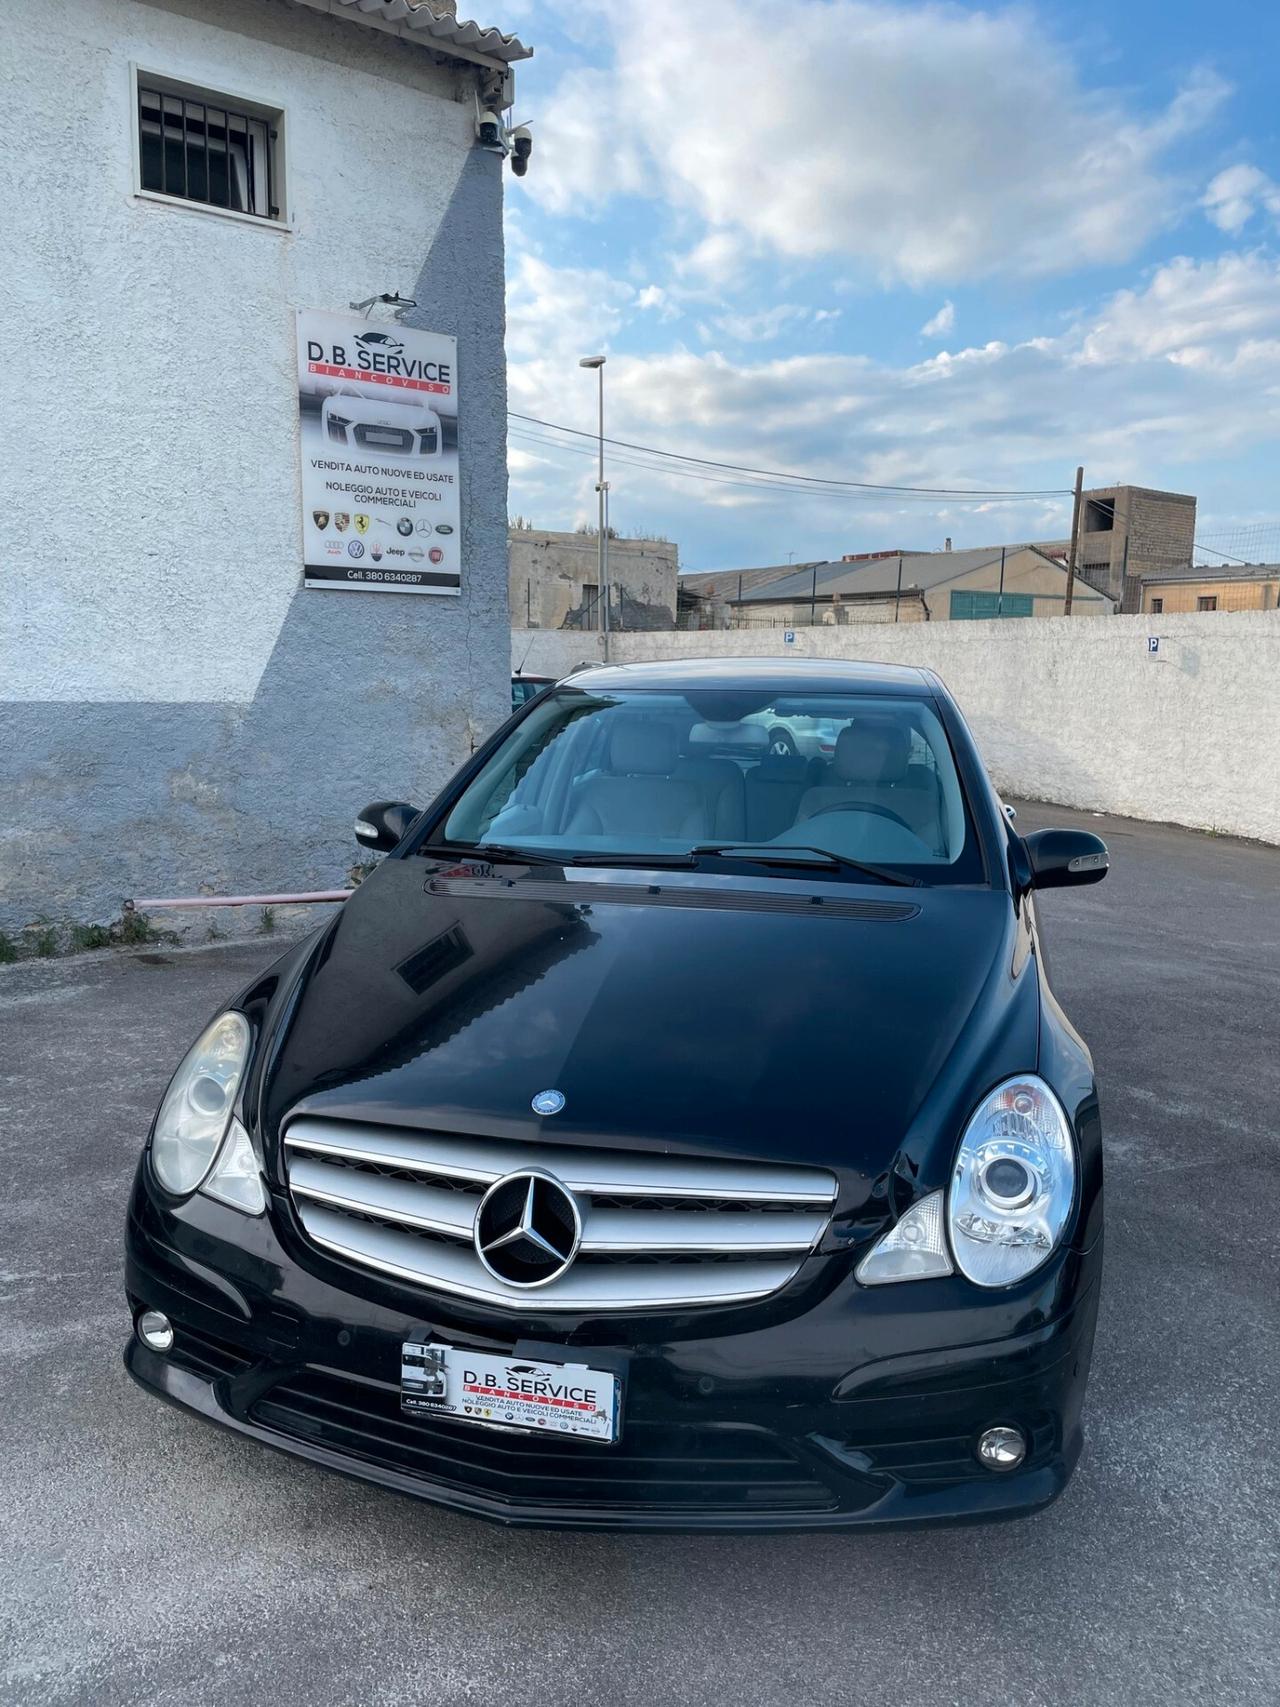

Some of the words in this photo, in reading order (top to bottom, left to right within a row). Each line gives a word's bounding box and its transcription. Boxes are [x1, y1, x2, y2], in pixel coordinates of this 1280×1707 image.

[307, 341, 352, 367] D.B.
[357, 350, 451, 384] SERVICE
[309, 363, 451, 394] BIANCOVISO
[311, 459, 352, 472] VENDITA
[354, 465, 380, 475] AUTO
[381, 468, 412, 479] NUOVE
[414, 472, 425, 480] ED
[426, 474, 454, 484] USATE
[325, 481, 374, 494] NOLEGGIO
[375, 486, 400, 497] AUTO
[402, 489, 407, 498] E
[408, 490, 442, 501] VEICOLI
[354, 494, 417, 508] COMMERCIALI
[386, 547, 405, 557] Jeep
[347, 570, 364, 579] Cell.
[365, 571, 383, 581] 380
[384, 573, 422, 583] 6340287
[1150, 638, 1158, 651] P
[463, 1370, 501, 1389] D.B.
[506, 1377, 597, 1404] SERVICE
[464, 1385, 595, 1411] BIANCOVISO
[462, 1398, 497, 1409] NOLEGGIO
[497, 1404, 516, 1412] AUTO
[522, 1408, 549, 1417] VEICOLI
[549, 1411, 597, 1425] COMMERCIALI
[475, 1395, 505, 1405] VENDITA
[506, 1399, 525, 1407] AUTO
[525, 1403, 550, 1411] NUOVE
[560, 1408, 583, 1417] USATE
